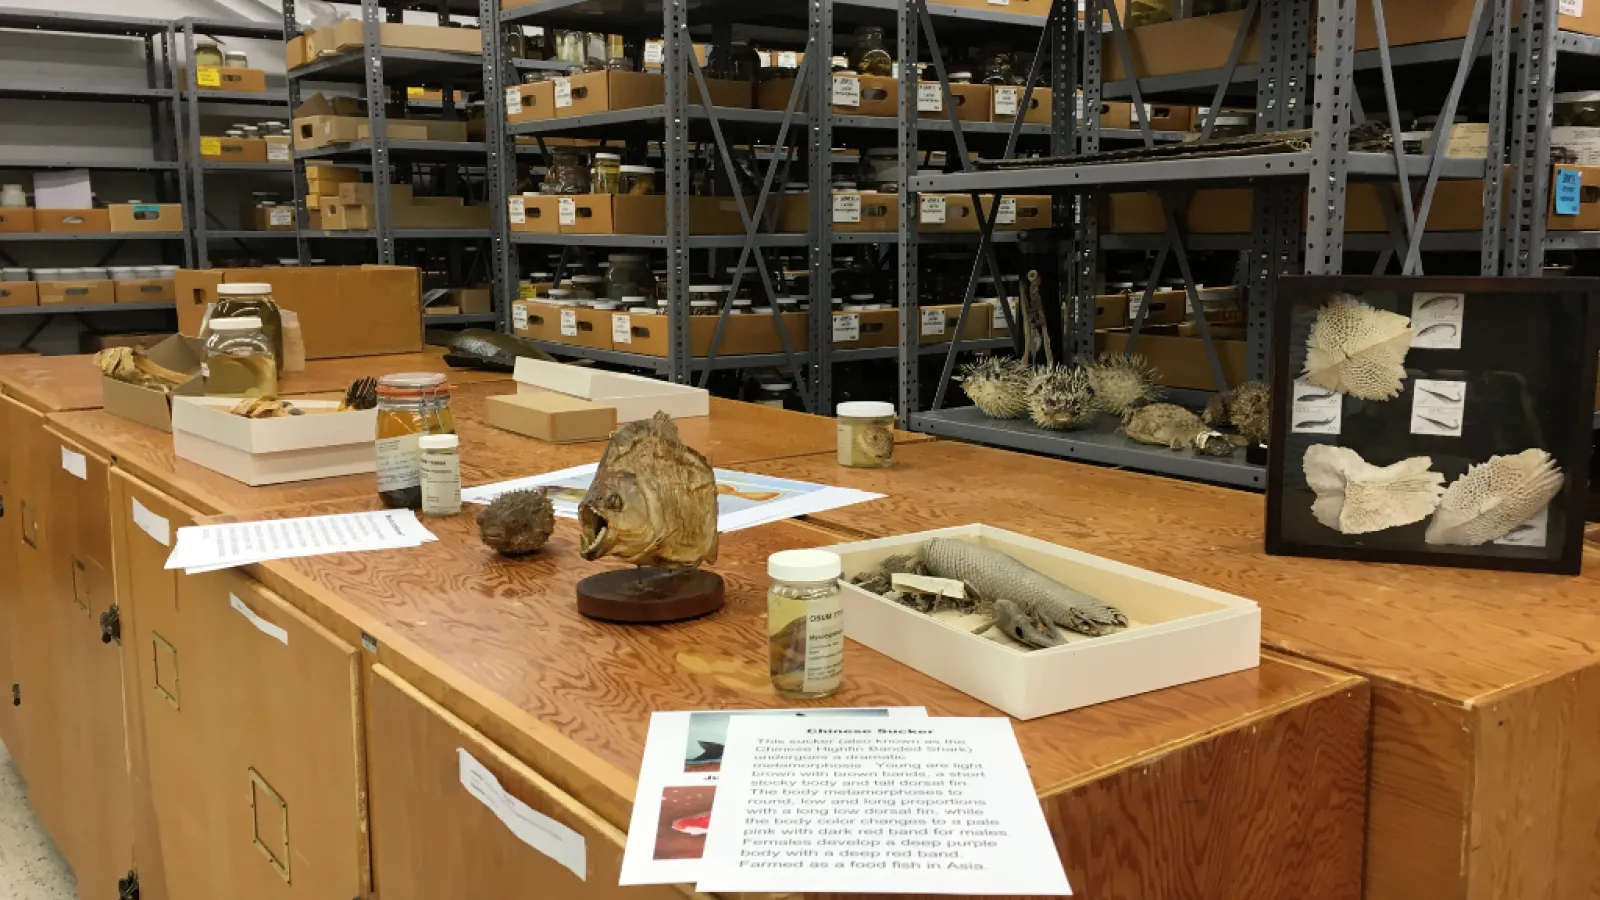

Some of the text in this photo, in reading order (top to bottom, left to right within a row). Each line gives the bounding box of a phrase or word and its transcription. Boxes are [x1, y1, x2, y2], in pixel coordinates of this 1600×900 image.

[810, 612, 832, 622] OSUM
[952, 762, 984, 771] light
[802, 779, 838, 788] body
[782, 788, 820, 797] body
[824, 788, 944, 797] metamorphoses
[863, 797, 896, 807] long
[900, 798, 986, 807] proportions
[796, 807, 830, 817] long
[944, 807, 984, 816] while
[774, 817, 812, 827] body
[816, 817, 854, 826] color
[860, 817, 928, 827] changes
[932, 817, 946, 826] to
[966, 818, 1000, 827] pale
[742, 827, 776, 837] pink
[888, 827, 928, 836] band
[932, 827, 954, 836] for
[816, 838, 880, 848] develop
[900, 838, 942, 849] deep
[946, 839, 998, 849] purple
[740, 848, 780, 859] body
[838, 849, 880, 859] deep
[885, 849, 912, 858] red
[850, 860, 887, 869] food
[891, 860, 921, 870] fish
[926, 861, 941, 870] in
